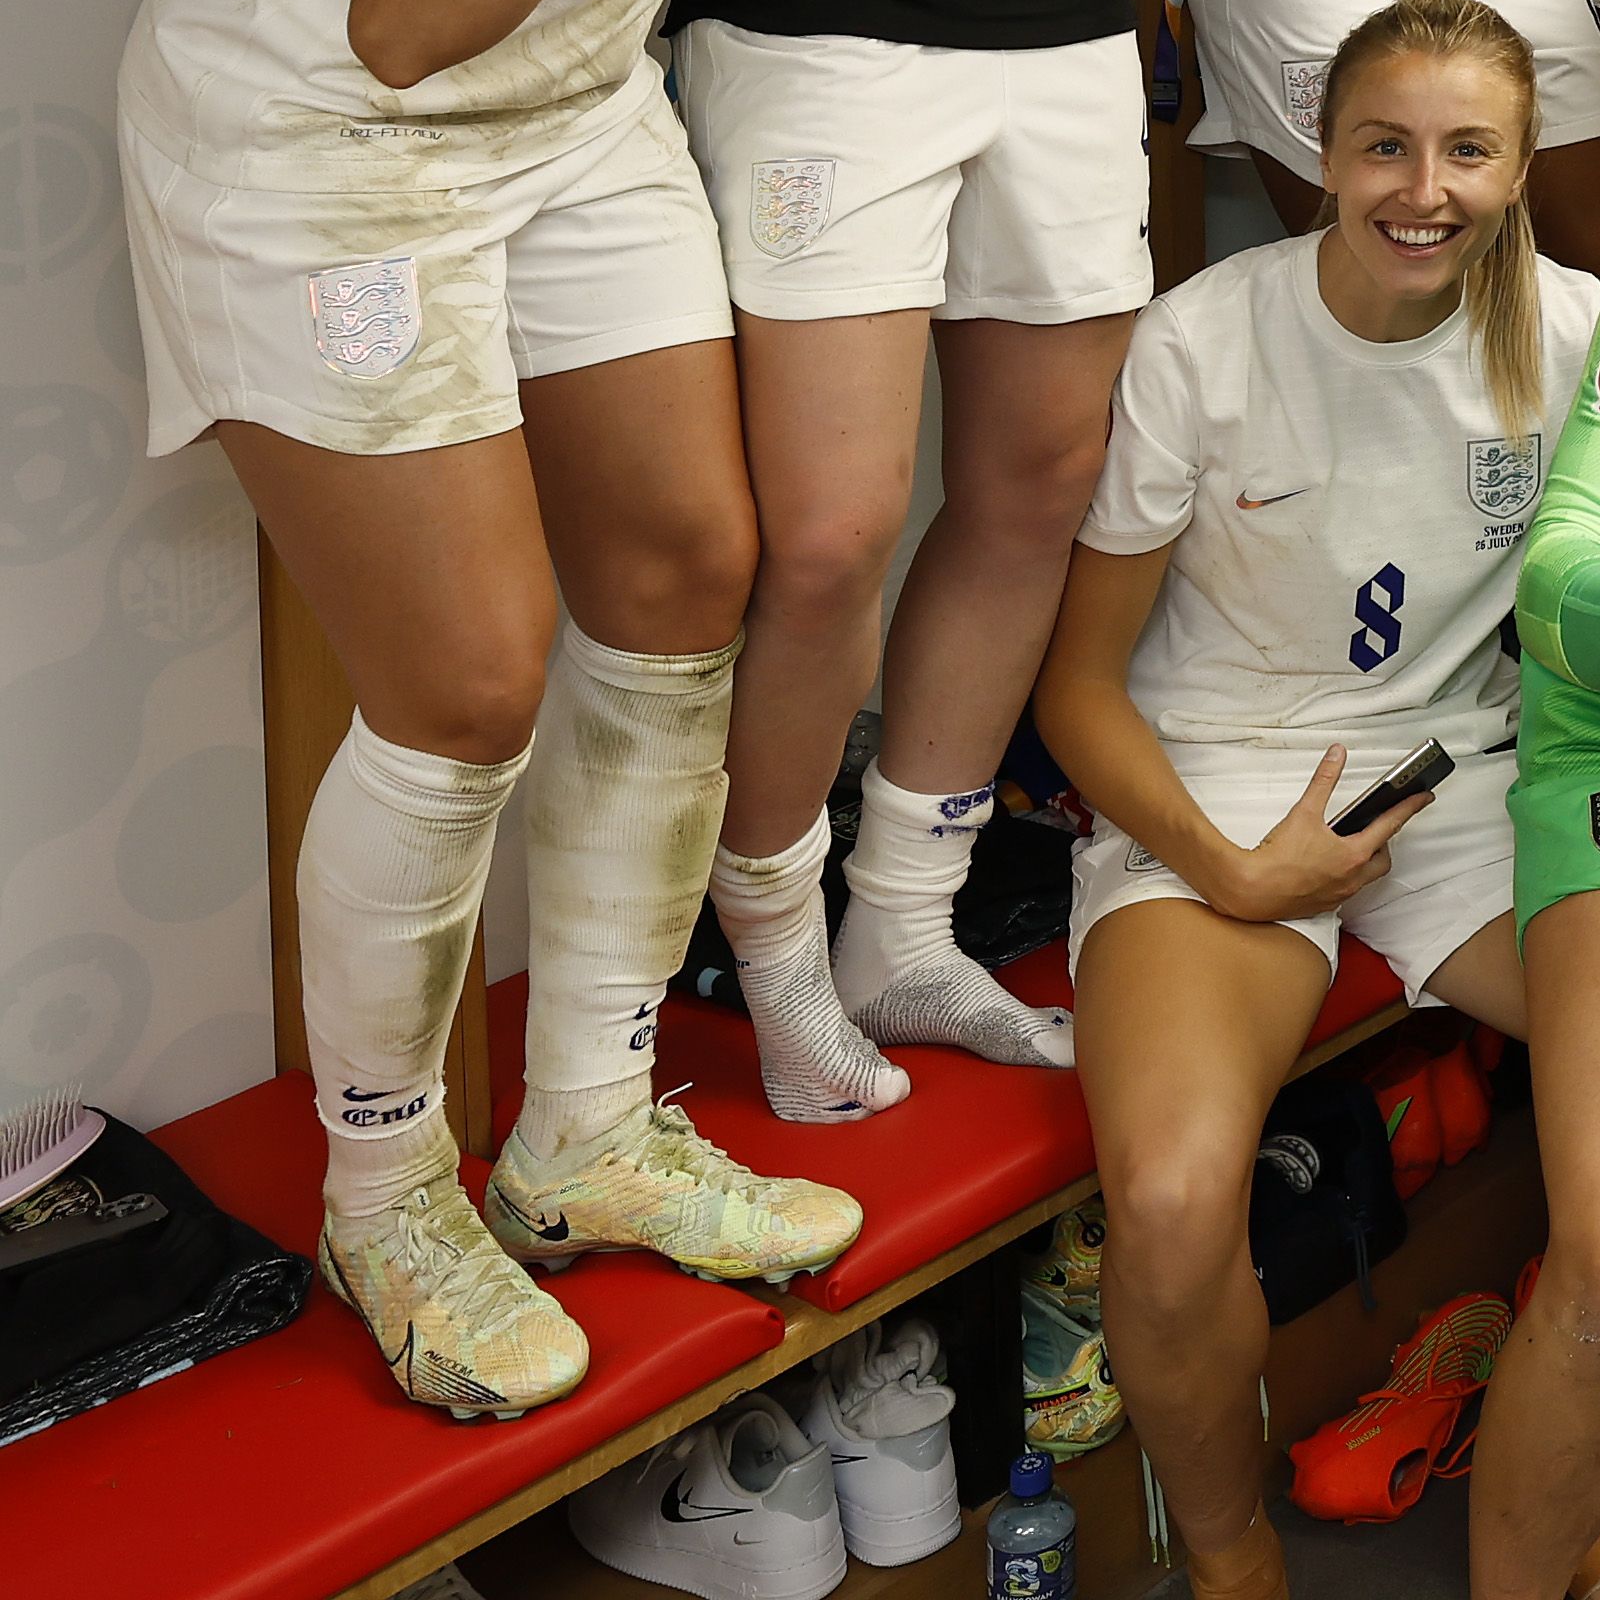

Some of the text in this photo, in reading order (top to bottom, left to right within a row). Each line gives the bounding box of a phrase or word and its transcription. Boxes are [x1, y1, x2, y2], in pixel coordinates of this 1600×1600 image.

[1483, 522, 1525, 538] SWEDEN
[1475, 539, 1486, 551] 26
[1487, 536, 1512, 550] JULY
[1348, 561, 1405, 673] 8
